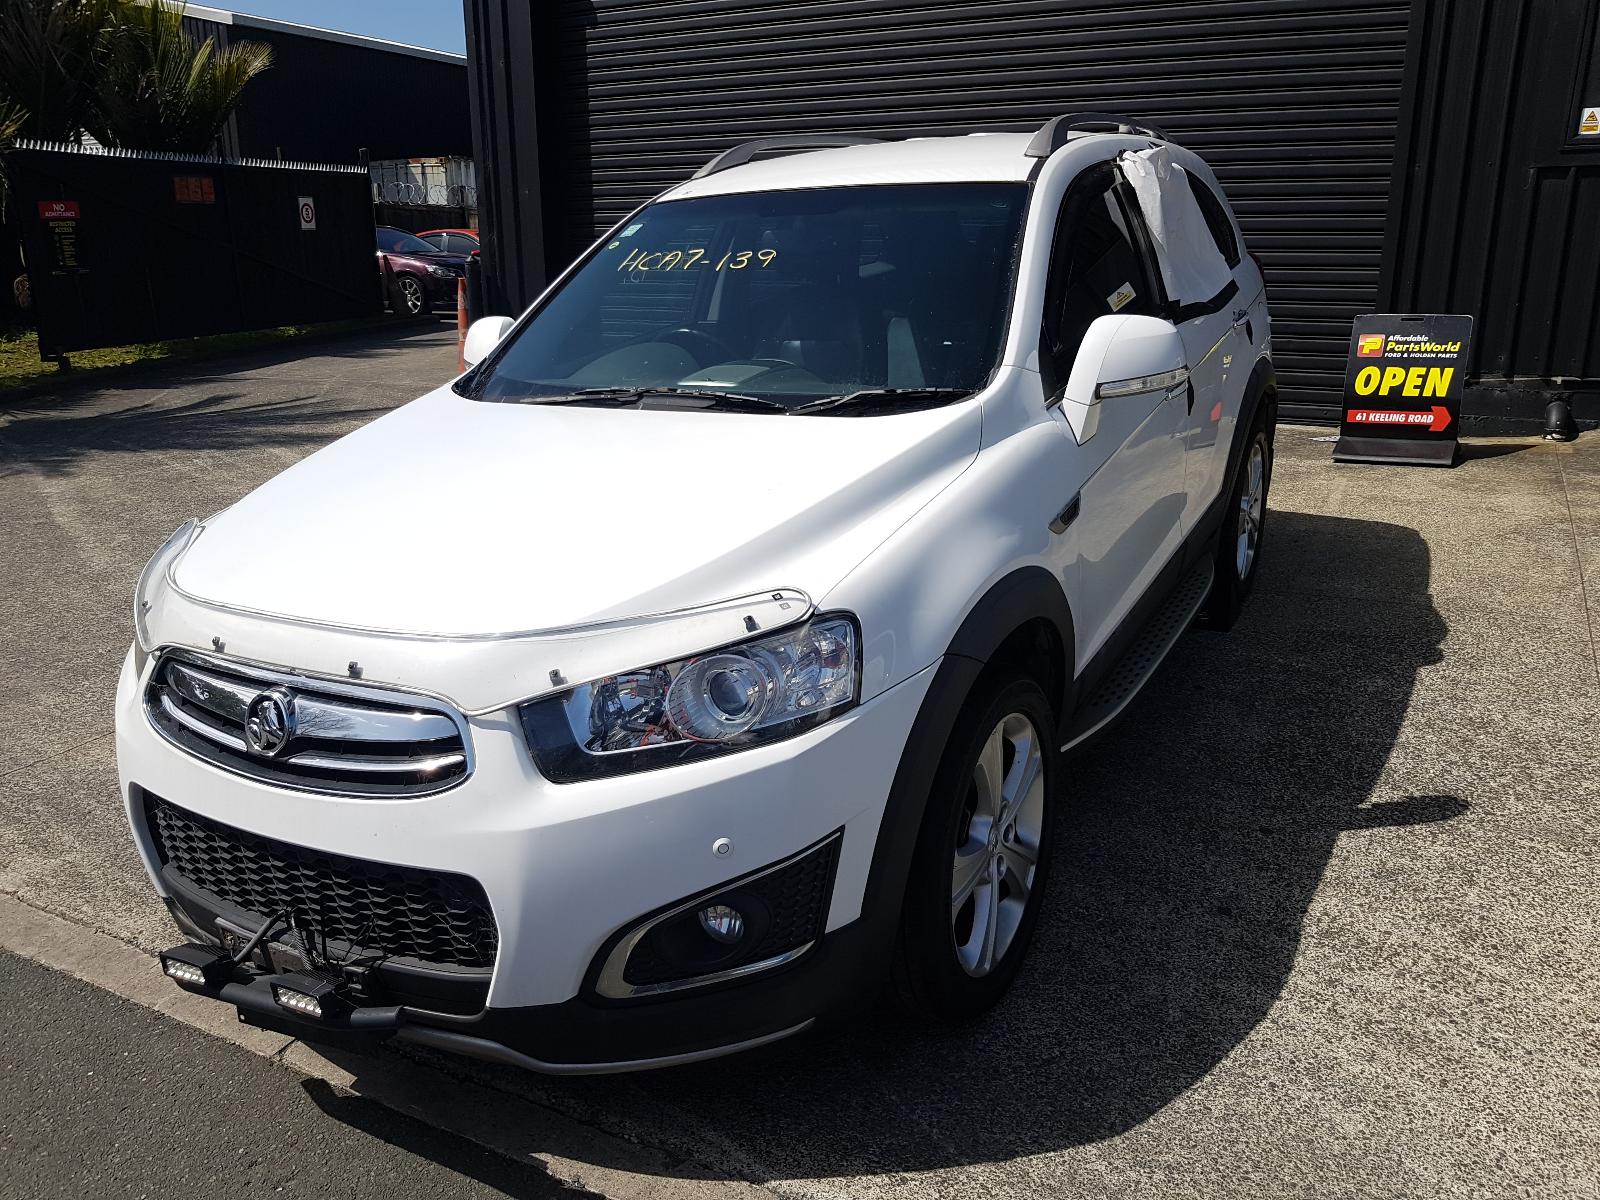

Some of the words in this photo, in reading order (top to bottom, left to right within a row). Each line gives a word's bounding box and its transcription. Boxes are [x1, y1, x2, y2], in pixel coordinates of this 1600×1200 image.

[52, 204, 65, 212] NO
[617, 248, 777, 272] HCA7-139
[1387, 334, 1429, 342] Affordable
[1386, 341, 1461, 352] PartsWorld
[1354, 366, 1455, 398] OPEN
[1355, 412, 1367, 421] 61
[1368, 413, 1406, 422] KEELING
[1407, 414, 1434, 423] ROAD
